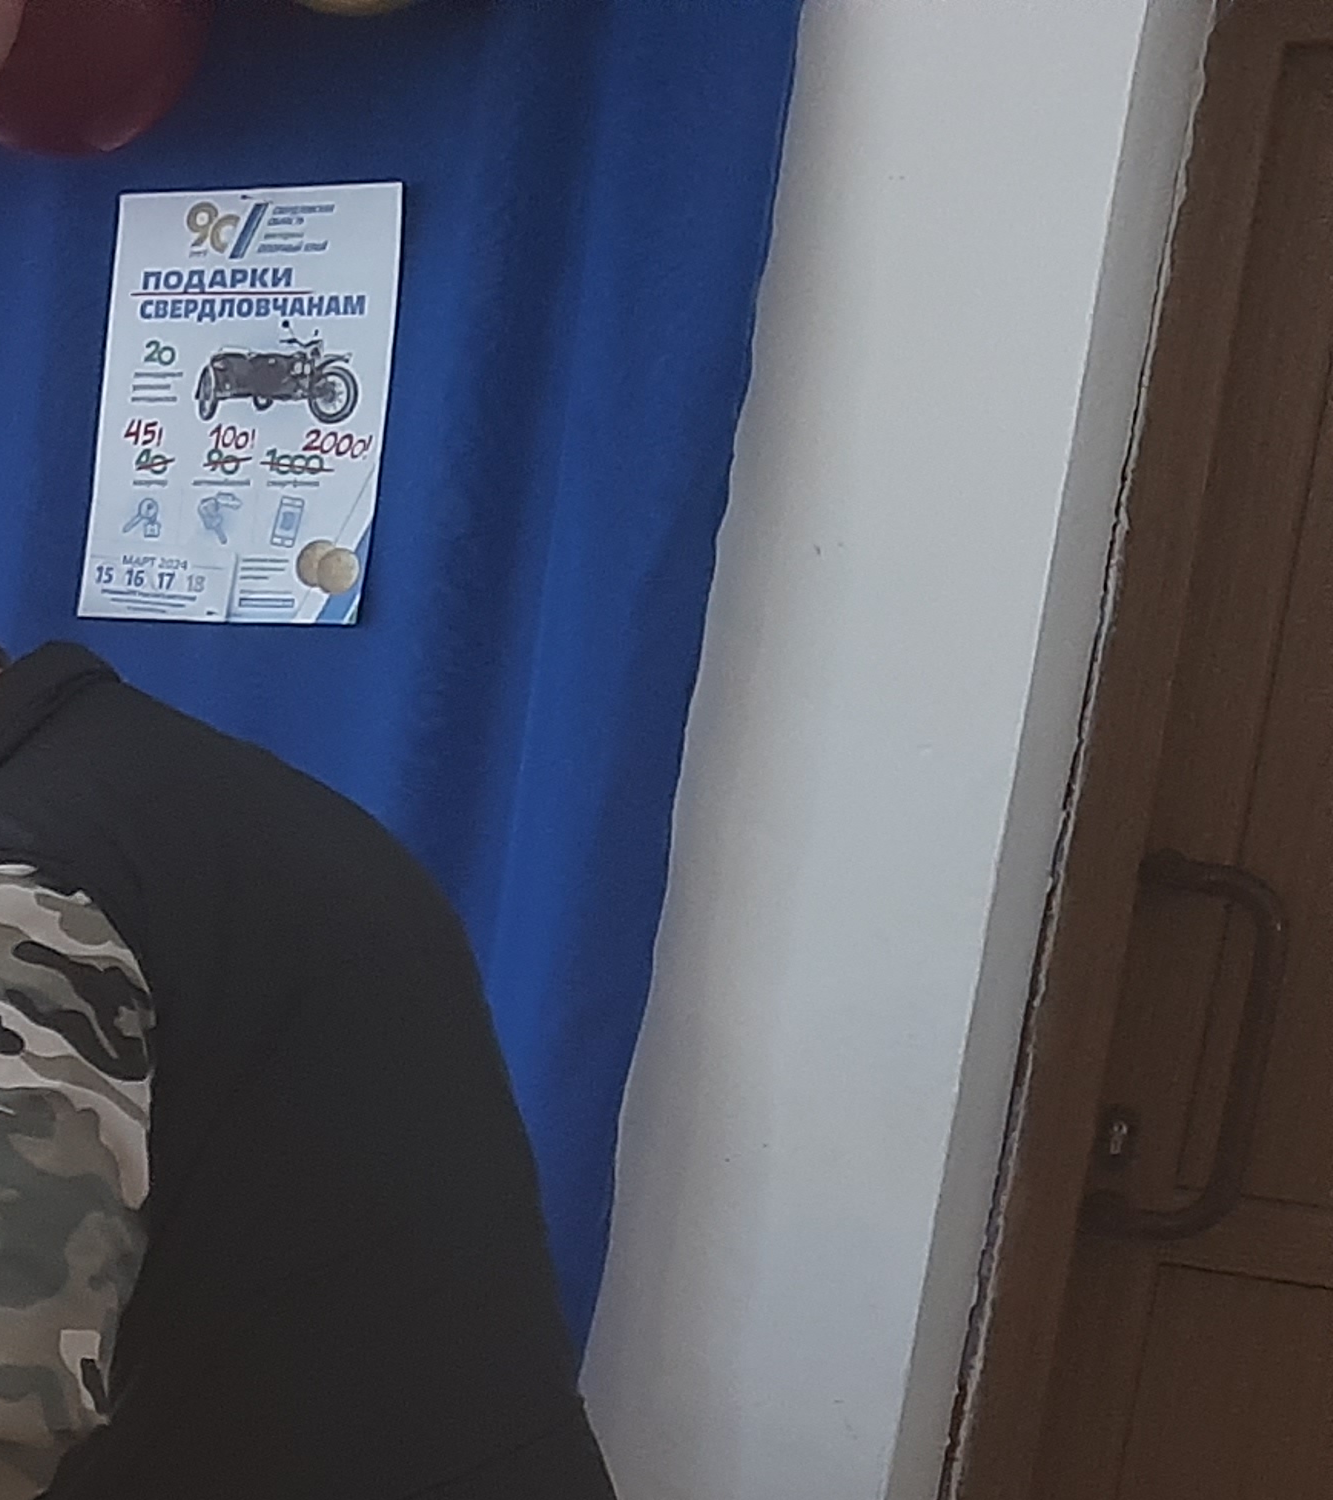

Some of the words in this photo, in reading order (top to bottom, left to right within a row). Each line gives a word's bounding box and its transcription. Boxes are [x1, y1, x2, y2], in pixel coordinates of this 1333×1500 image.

[142, 267, 293, 293] ПОДАРКИ
[139, 295, 366, 322] СВЕРДЛОВЧАНАМ
[144, 340, 176, 366] 20
[124, 419, 164, 447] 45!
[209, 424, 256, 449] 100!
[302, 428, 373, 459] 2000!
[95, 566, 114, 584] 15
[125, 569, 145, 588] 16
[157, 572, 175, 590] 17
[186, 573, 206, 593] 18
